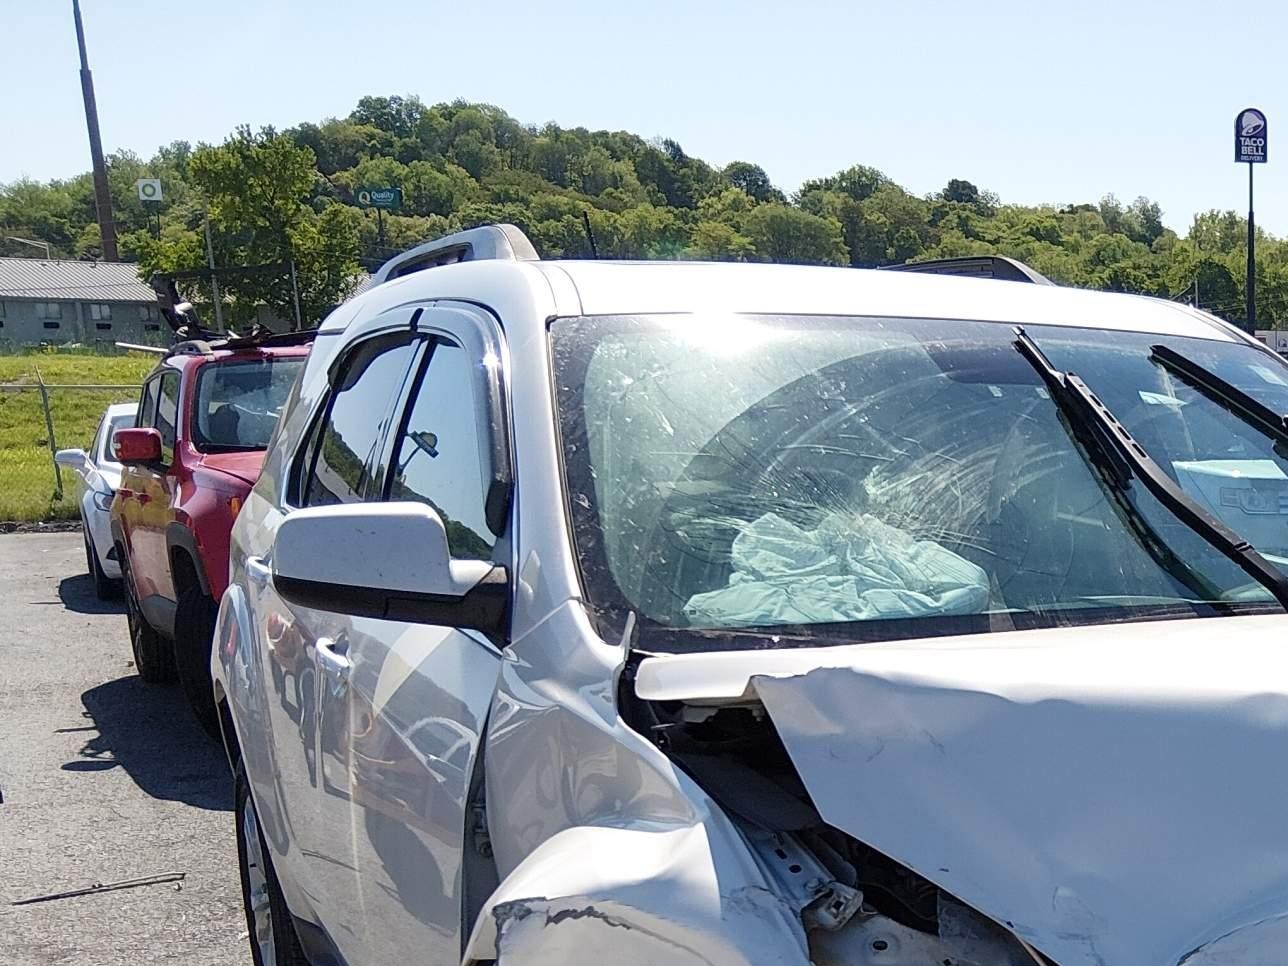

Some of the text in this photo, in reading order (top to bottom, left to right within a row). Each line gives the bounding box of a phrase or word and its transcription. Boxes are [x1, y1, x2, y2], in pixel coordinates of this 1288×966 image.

[1239, 137, 1264, 147] TACO
[1241, 146, 1264, 155] BELL
[371, 191, 394, 202] Quality
